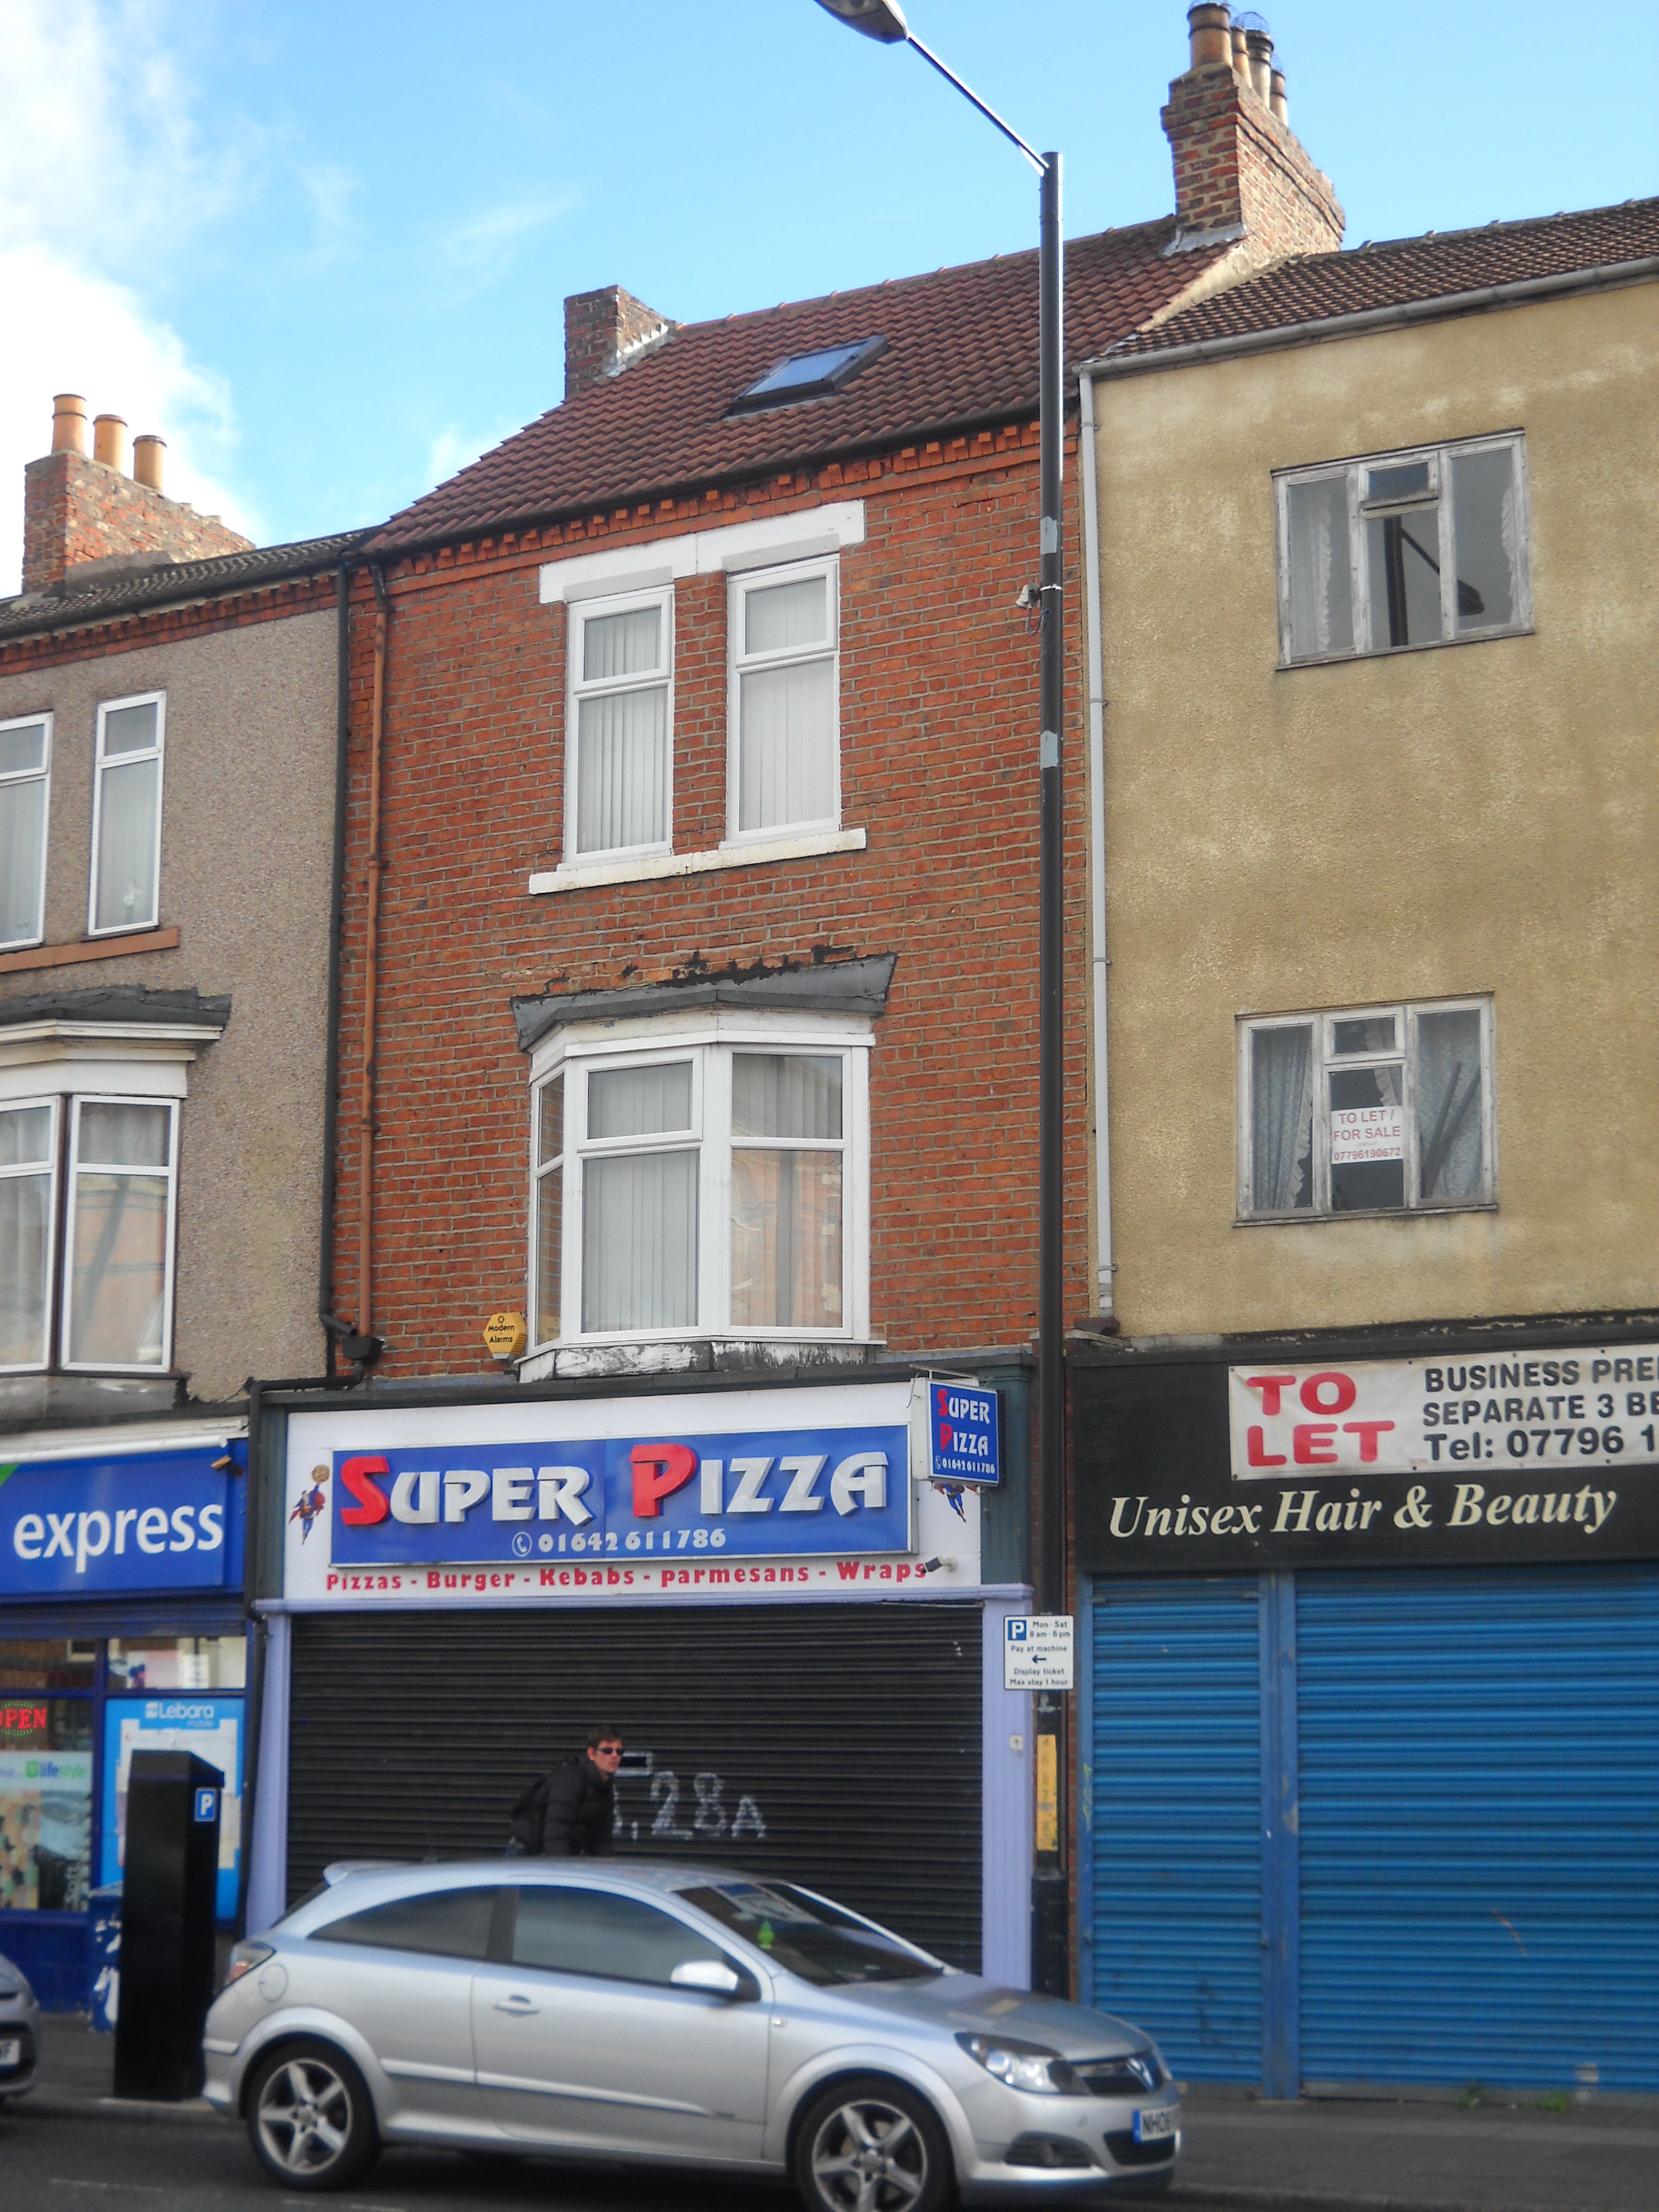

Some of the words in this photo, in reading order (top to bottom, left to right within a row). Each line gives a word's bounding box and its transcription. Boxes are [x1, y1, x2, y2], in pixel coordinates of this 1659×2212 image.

[1338, 1112, 1357, 1124] TO
[1361, 1110, 1386, 1122] LET
[1333, 1129, 1361, 1141] FOR
[1364, 1126, 1401, 1139] SALE
[1335, 1147, 1401, 1161] 07796190672
[488, 1324, 515, 1332] Modern
[1425, 1360, 1579, 1392] BUSINESS
[1592, 1357, 1659, 1383] PRE
[937, 1389, 990, 1424] SUPER
[1247, 1372, 1356, 1416] TO
[1423, 1395, 1584, 1426] SEPARATE
[1597, 1393, 1614, 1418] 3
[940, 1424, 988, 1456] PIZZA
[1247, 1420, 1394, 1467] LET
[1424, 1432, 1493, 1461] Tel:
[1507, 1426, 1624, 1457] 07796
[1641, 1424, 1655, 1452] 1
[340, 1456, 597, 1526] SUPER
[629, 1443, 889, 1517] PIZZA
[1110, 1494, 1263, 1538] Unisex
[1270, 1487, 1382, 1533] Hair
[1393, 1485, 1432, 1529] &
[1446, 1483, 1617, 1533] Beauty
[13, 1504, 223, 1574] express
[326, 1574, 401, 1590] Pizzas
[427, 1571, 515, 1590] Burger
[540, 1568, 634, 1586] Kebabs
[661, 1566, 809, 1587] parmesans
[837, 1561, 926, 1583] Wraps
[1011, 1621, 1025, 1640] P
[158, 1702, 214, 1719] Lebara
[201, 1793, 213, 1816] P
